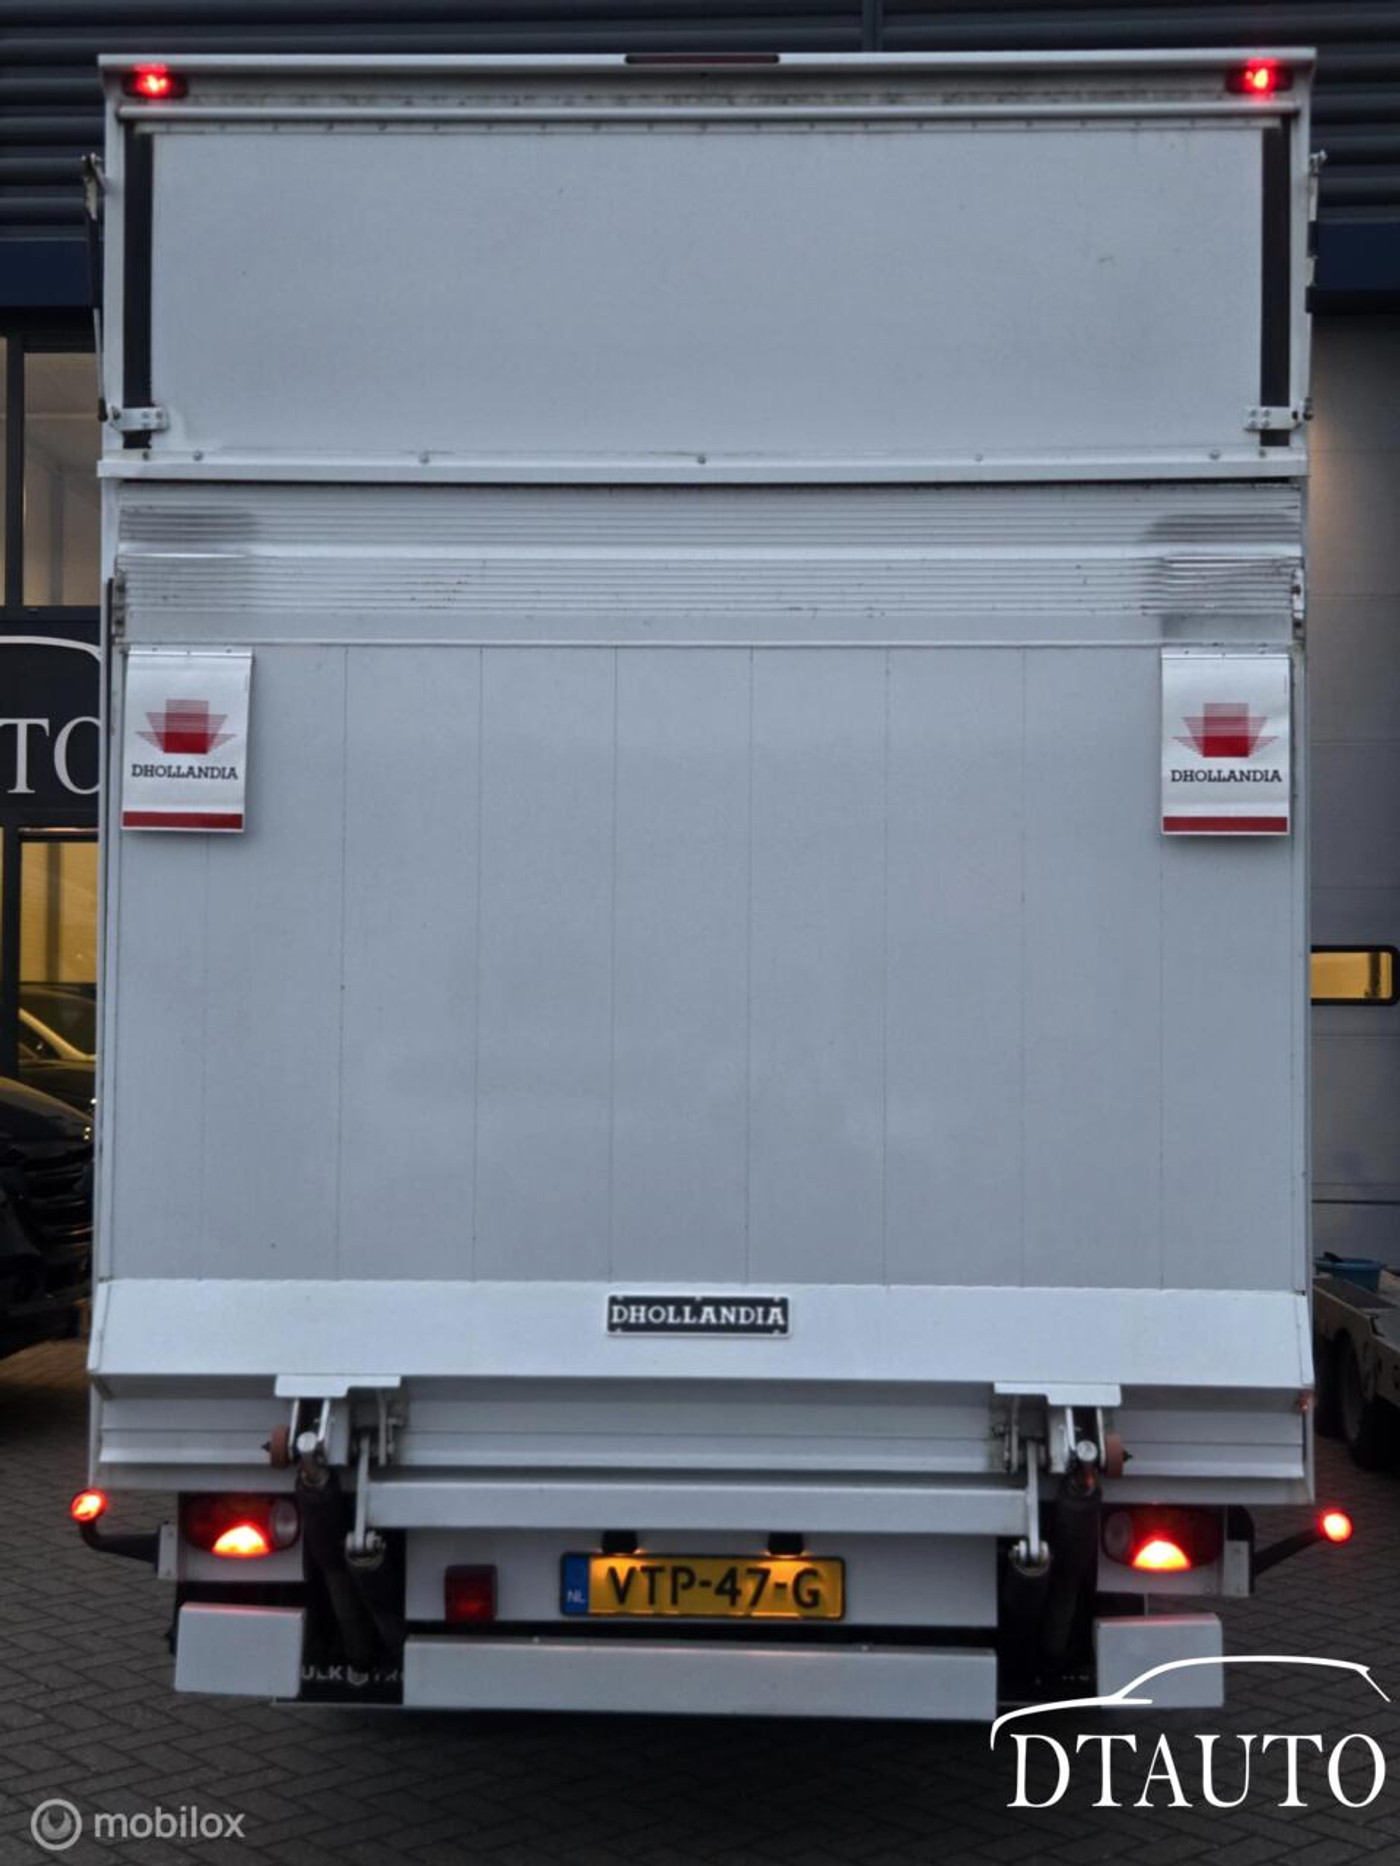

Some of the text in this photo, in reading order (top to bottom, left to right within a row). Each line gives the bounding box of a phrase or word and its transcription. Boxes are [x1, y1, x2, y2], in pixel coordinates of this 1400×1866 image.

[131, 763, 239, 781] DHOLLANDIA
[1170, 769, 1283, 783] DHOLLANDIA
[611, 1304, 785, 1326] DHOLLANDIA
[566, 1565, 820, 1609] NL VTP-47-G
